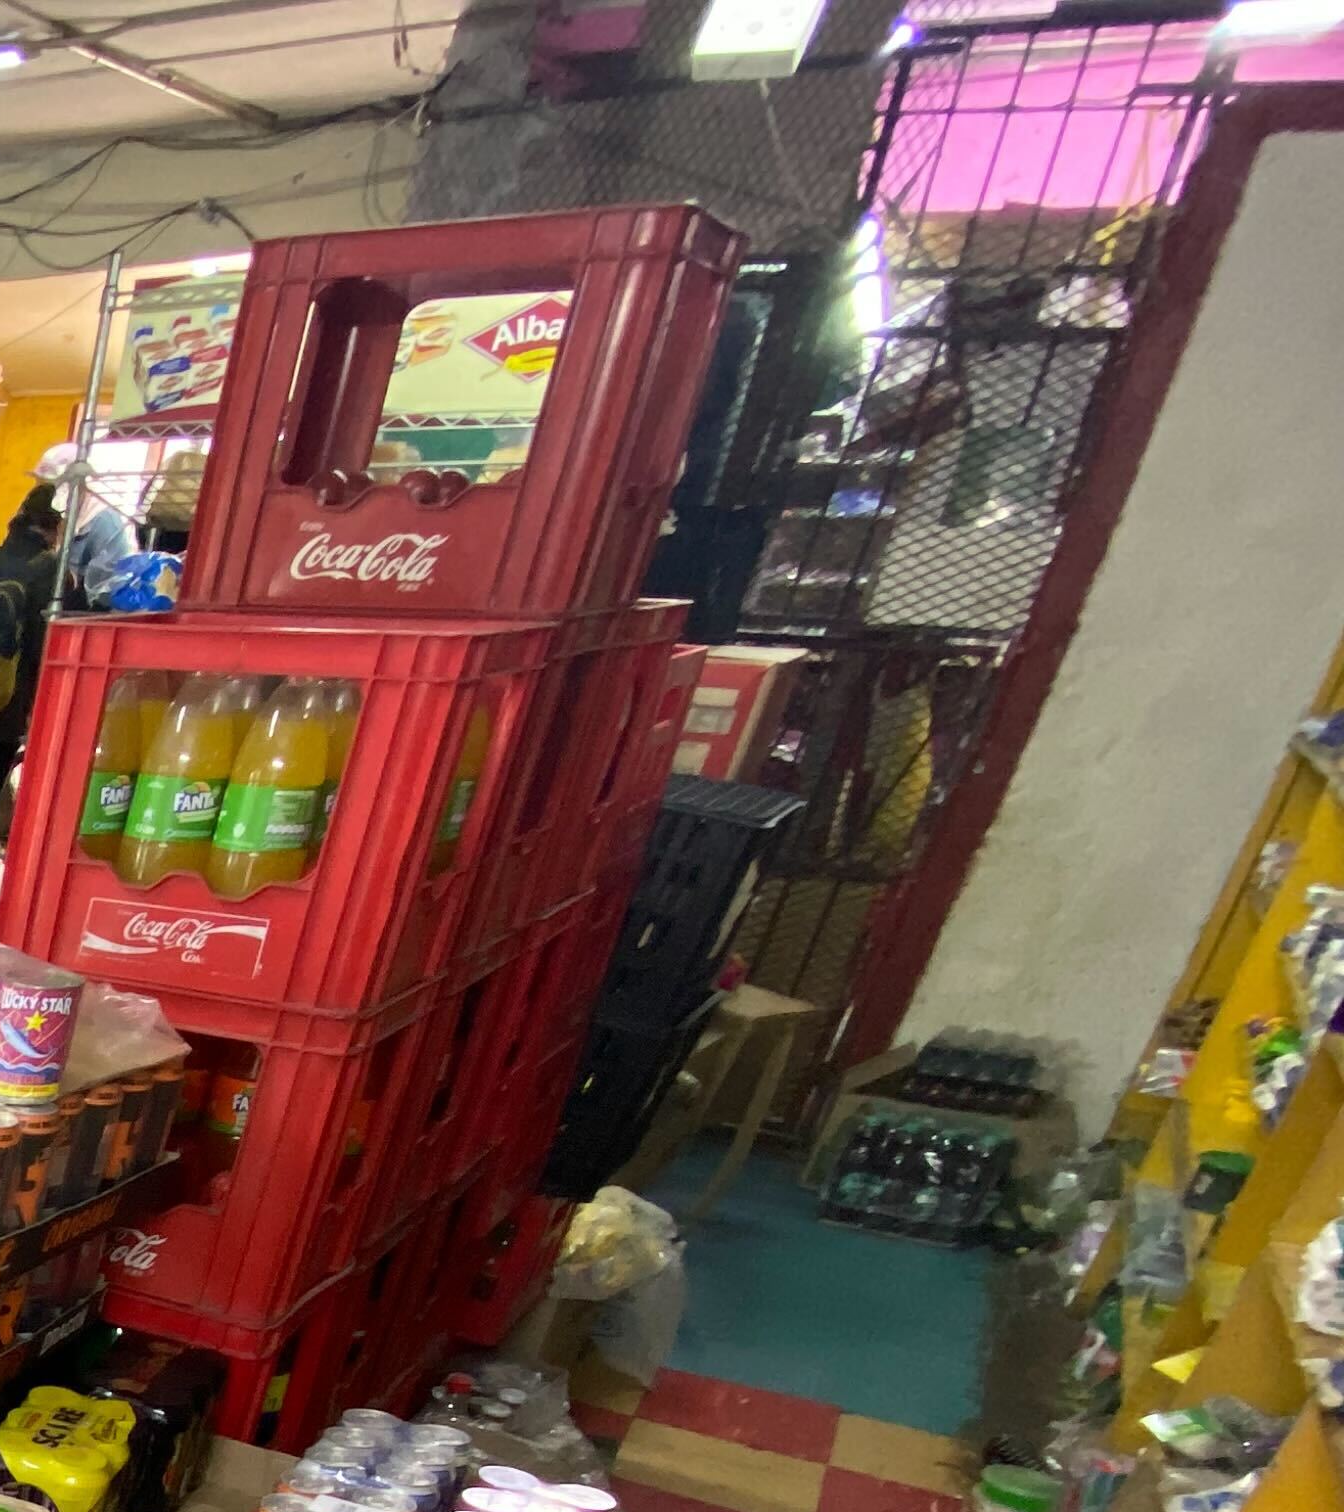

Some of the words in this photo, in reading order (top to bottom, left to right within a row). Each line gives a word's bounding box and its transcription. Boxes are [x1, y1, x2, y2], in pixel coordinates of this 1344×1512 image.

[290, 532, 451, 582] Coca-Cola
[123, 911, 214, 950] Coca-Cola
[40, 996, 73, 1016] STAR
